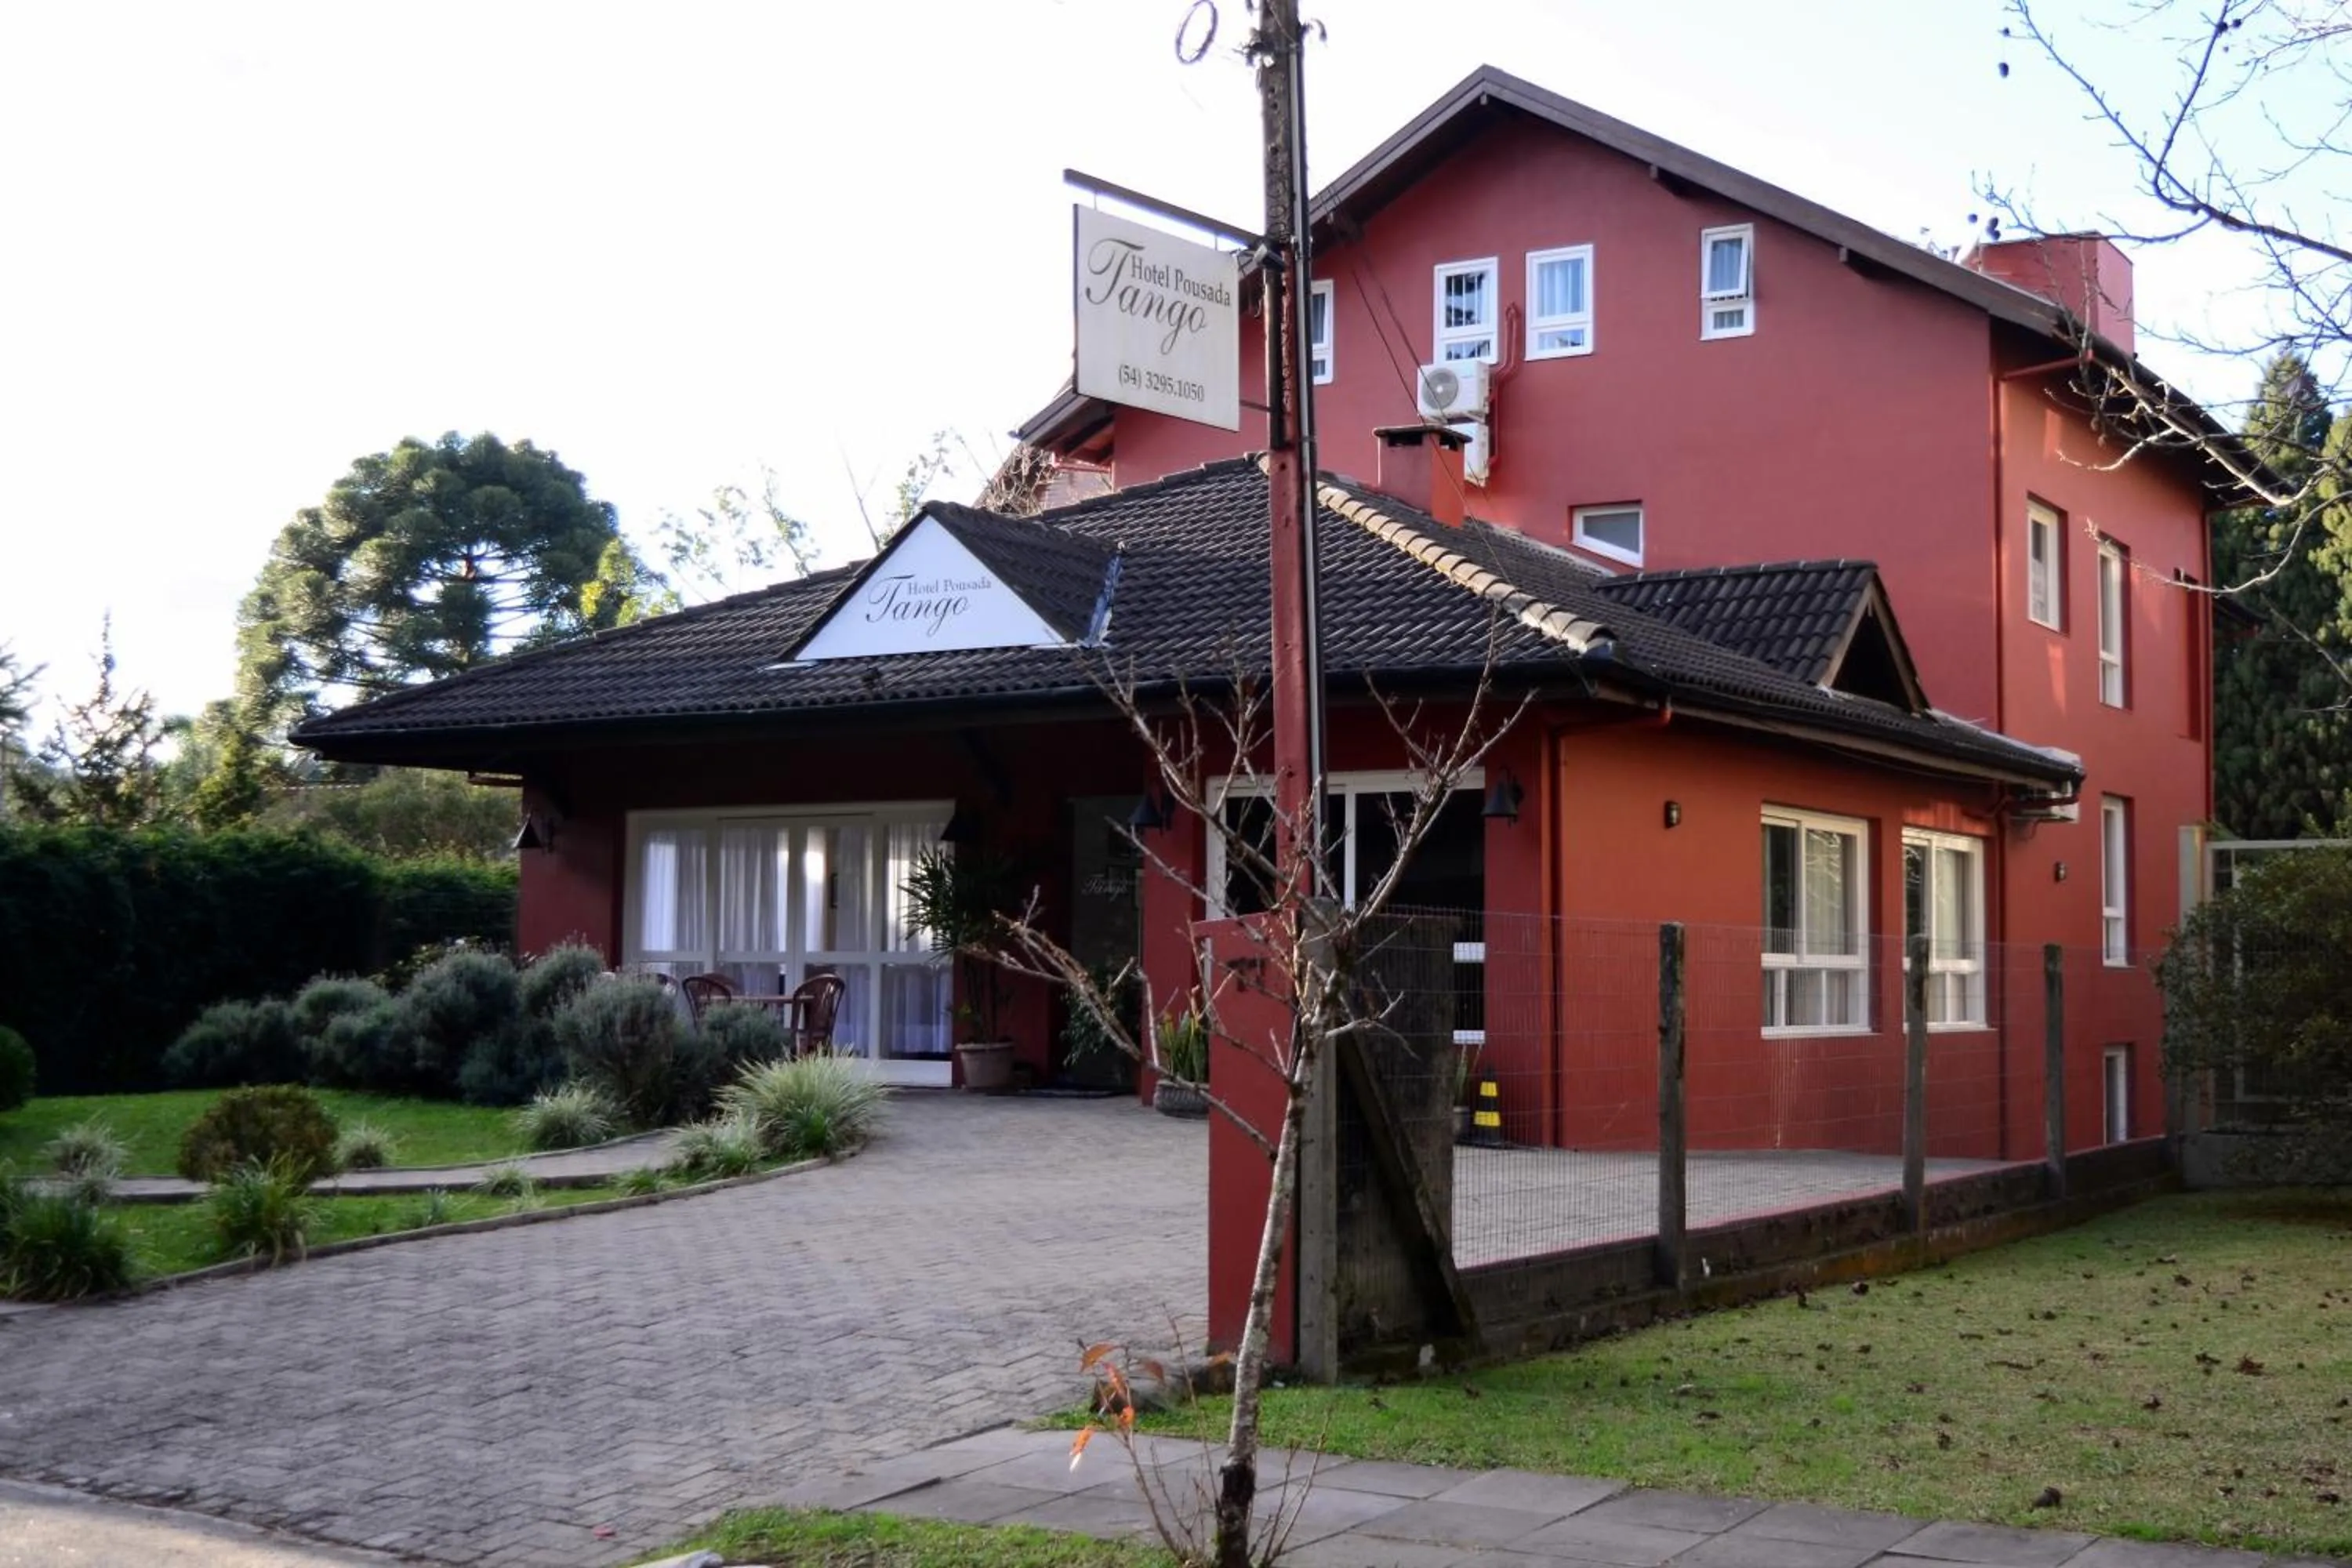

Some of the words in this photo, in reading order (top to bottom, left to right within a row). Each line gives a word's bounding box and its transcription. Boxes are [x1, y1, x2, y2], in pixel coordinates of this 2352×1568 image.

[1085, 238, 1207, 356] Tango
[1131, 253, 1170, 289] Hotel
[1174, 268, 1232, 307] Pousada
[1118, 363, 1142, 390] (54)
[1145, 371, 1204, 403] 3295.1050
[865, 573, 971, 637] Tango
[907, 579, 939, 596] Hotel
[943, 575, 993, 593] Pousada
